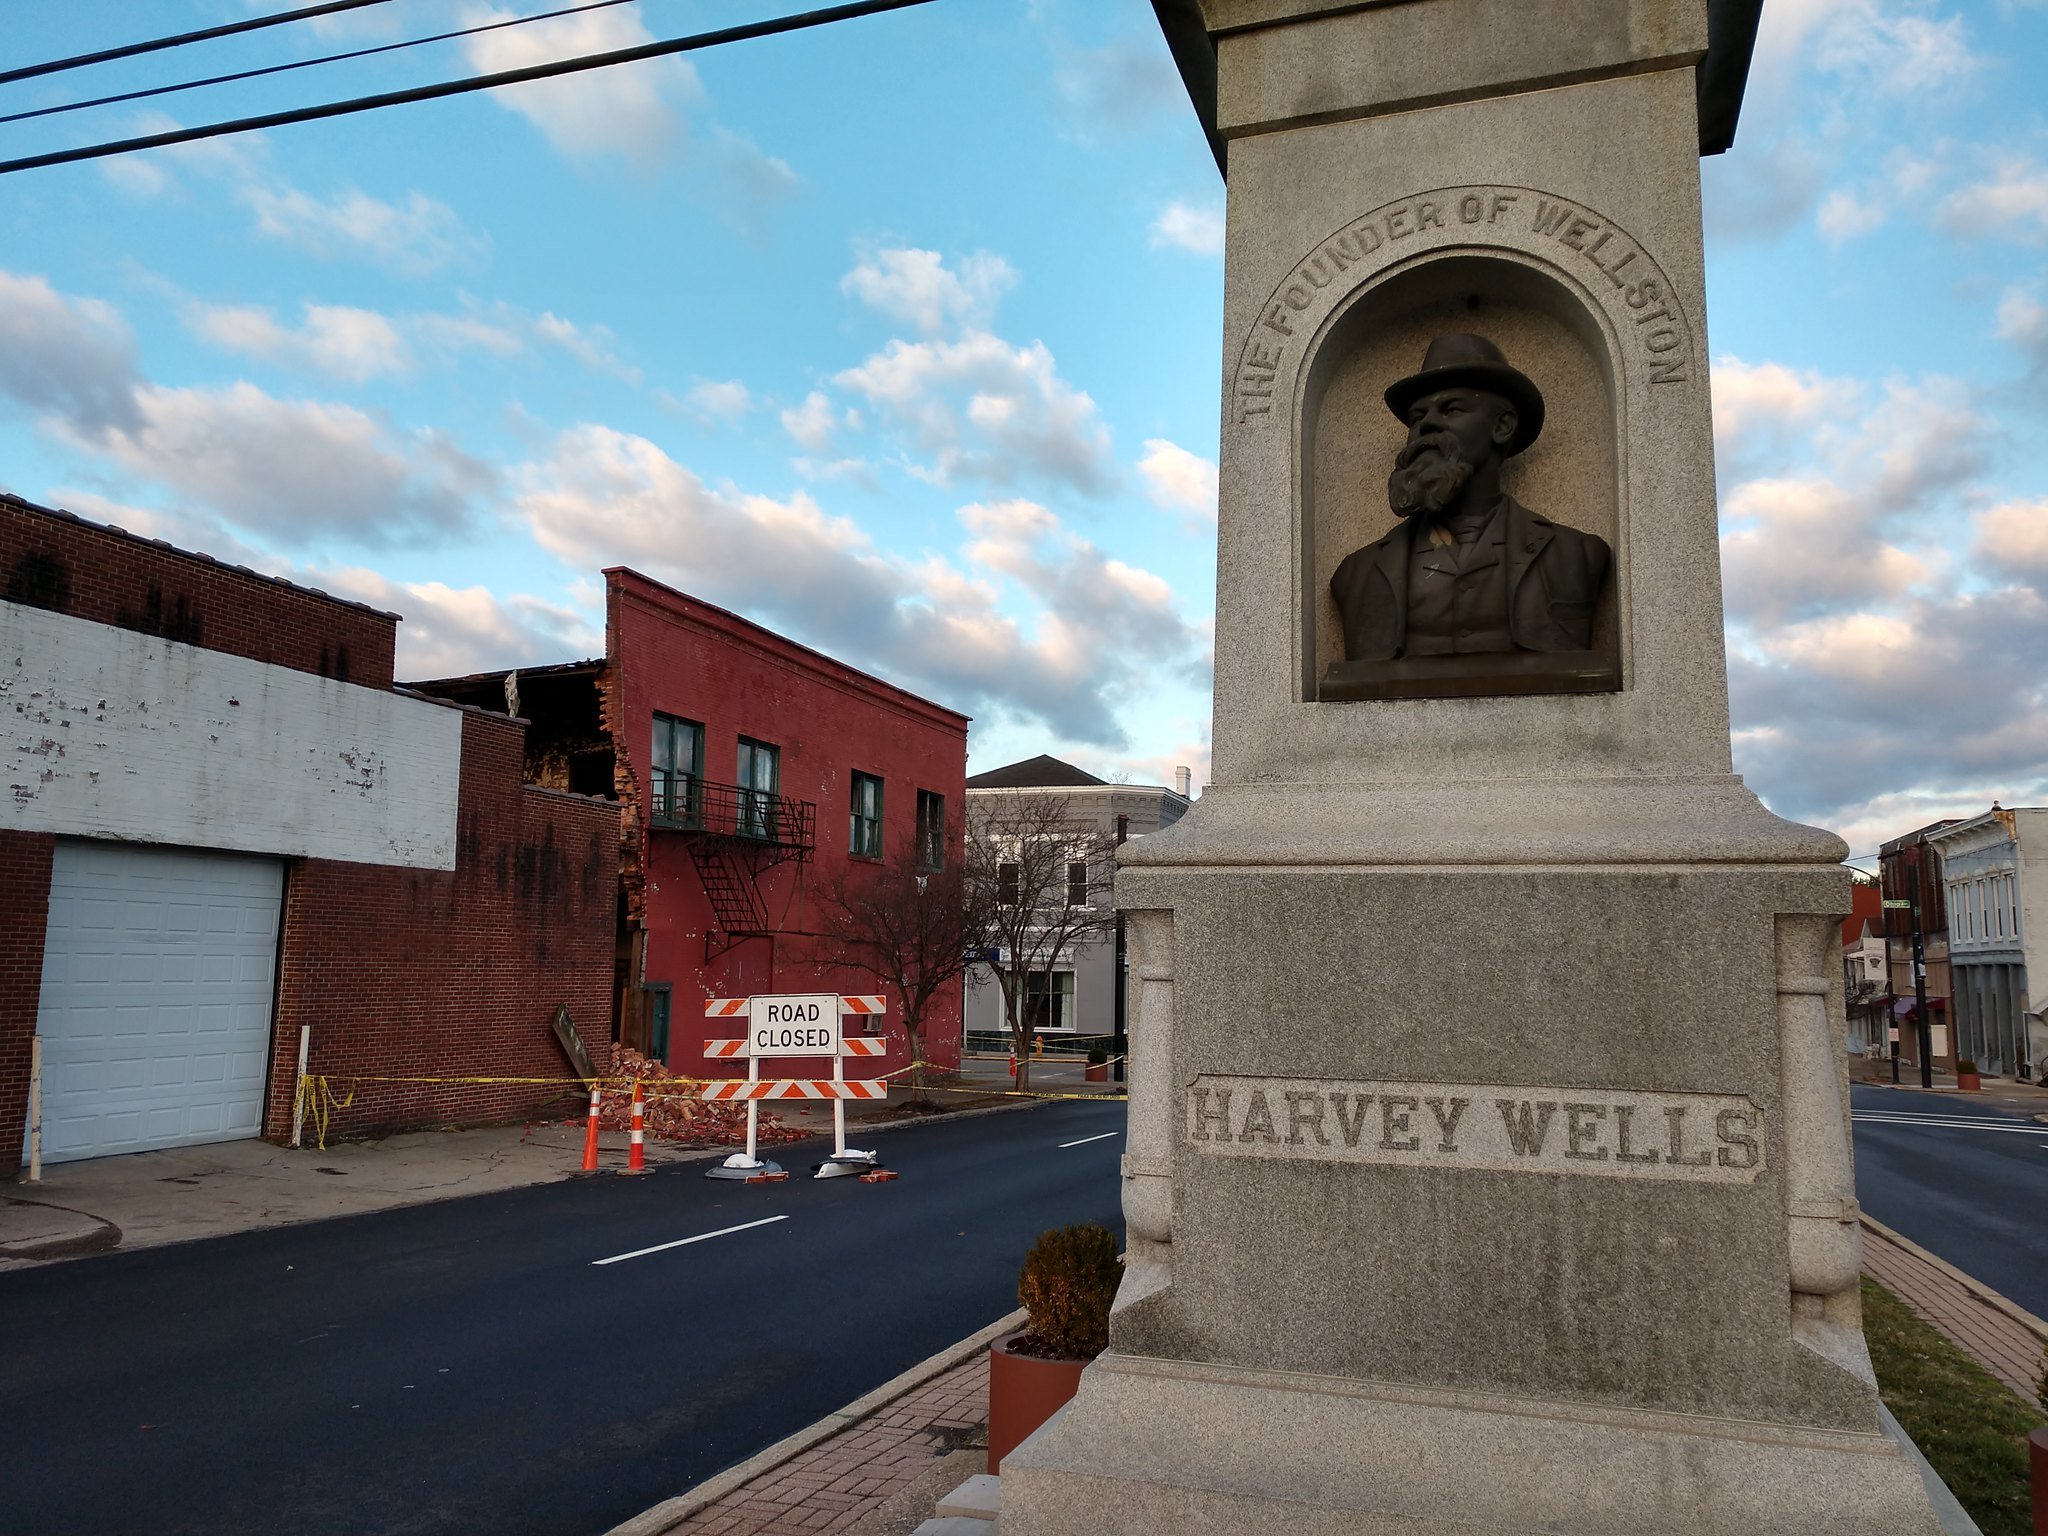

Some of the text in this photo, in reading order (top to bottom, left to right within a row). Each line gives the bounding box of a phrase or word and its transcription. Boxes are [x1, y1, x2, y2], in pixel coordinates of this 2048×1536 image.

[1239, 193, 1687, 424] THE FOUNDER OF WELLSTON
[757, 1028, 831, 1048] CLOSED
[768, 1003, 820, 1023] ROAD
[1191, 1086, 1759, 1169] HARVEY WELLS
